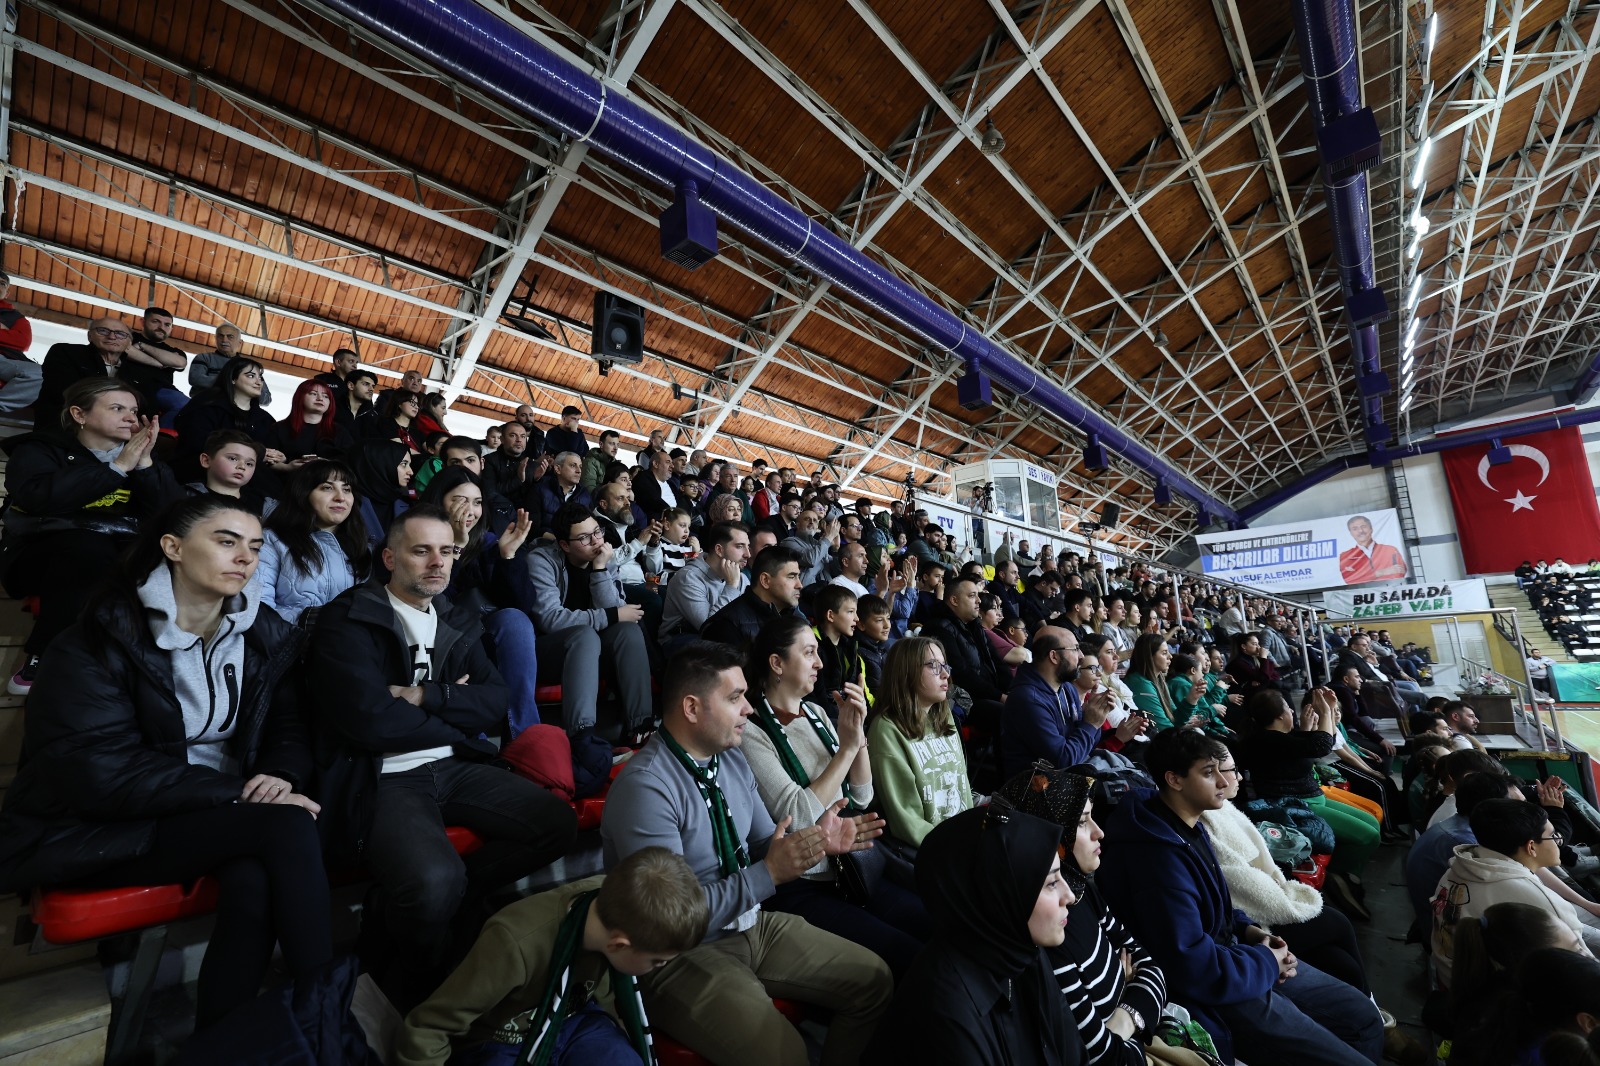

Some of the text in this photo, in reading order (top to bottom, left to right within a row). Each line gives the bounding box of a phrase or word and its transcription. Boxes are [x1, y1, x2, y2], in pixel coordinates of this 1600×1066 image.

[937, 515, 954, 530] TV
[1212, 542, 1226, 553] TÜM
[1226, 541, 1252, 552] SPORCU
[1253, 540, 1261, 548] VE
[1211, 546, 1280, 573] BAŞARILAR
[1230, 572, 1263, 584] YUSUF
[1263, 567, 1312, 581] ALEMDAR
[1353, 584, 1452, 606] BU SAHADA
[1352, 602, 1402, 619] ZAFER
